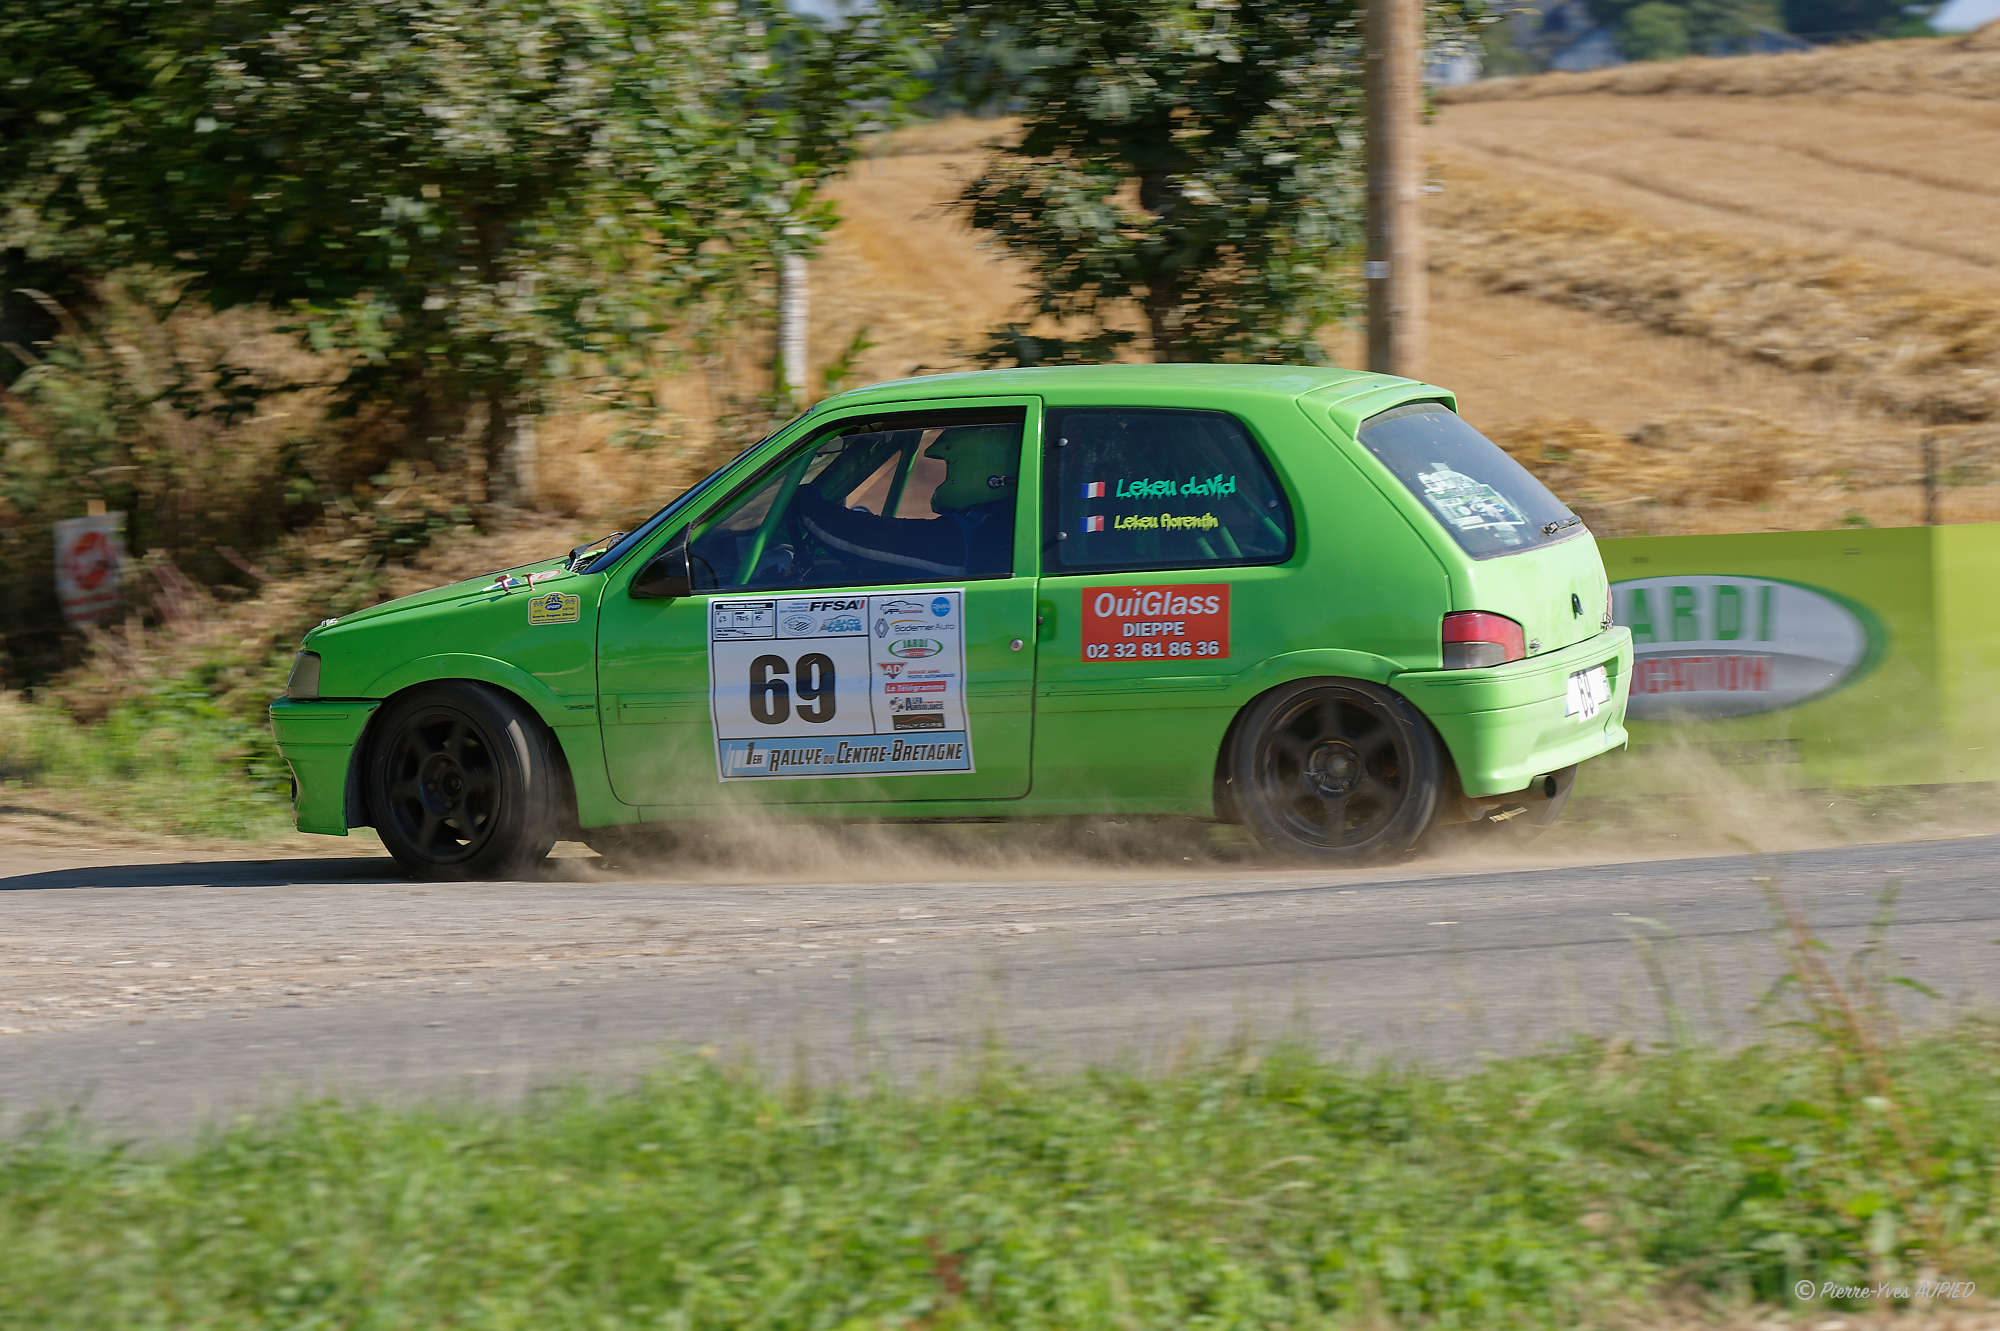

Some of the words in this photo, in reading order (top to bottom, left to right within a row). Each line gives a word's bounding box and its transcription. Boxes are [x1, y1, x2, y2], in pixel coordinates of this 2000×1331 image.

[1115, 477, 1177, 500] Lekeu
[1114, 514, 1160, 531] Lekeu
[809, 600, 858, 612] FFSA
[1094, 587, 1221, 618] OuiGlass
[1624, 585, 1777, 643] ARDI
[1122, 621, 1185, 637] DIEPPE
[1087, 644, 1109, 658] 02
[1113, 643, 1136, 658] 32
[1141, 642, 1164, 657] 81
[1168, 641, 1192, 656] 86
[1196, 640, 1219, 656] 36
[885, 665, 903, 673] AD
[749, 652, 837, 725] 69
[767, 748, 823, 772] RALLYE
[836, 739, 964, 764] CENTRE-BRETAGNE
